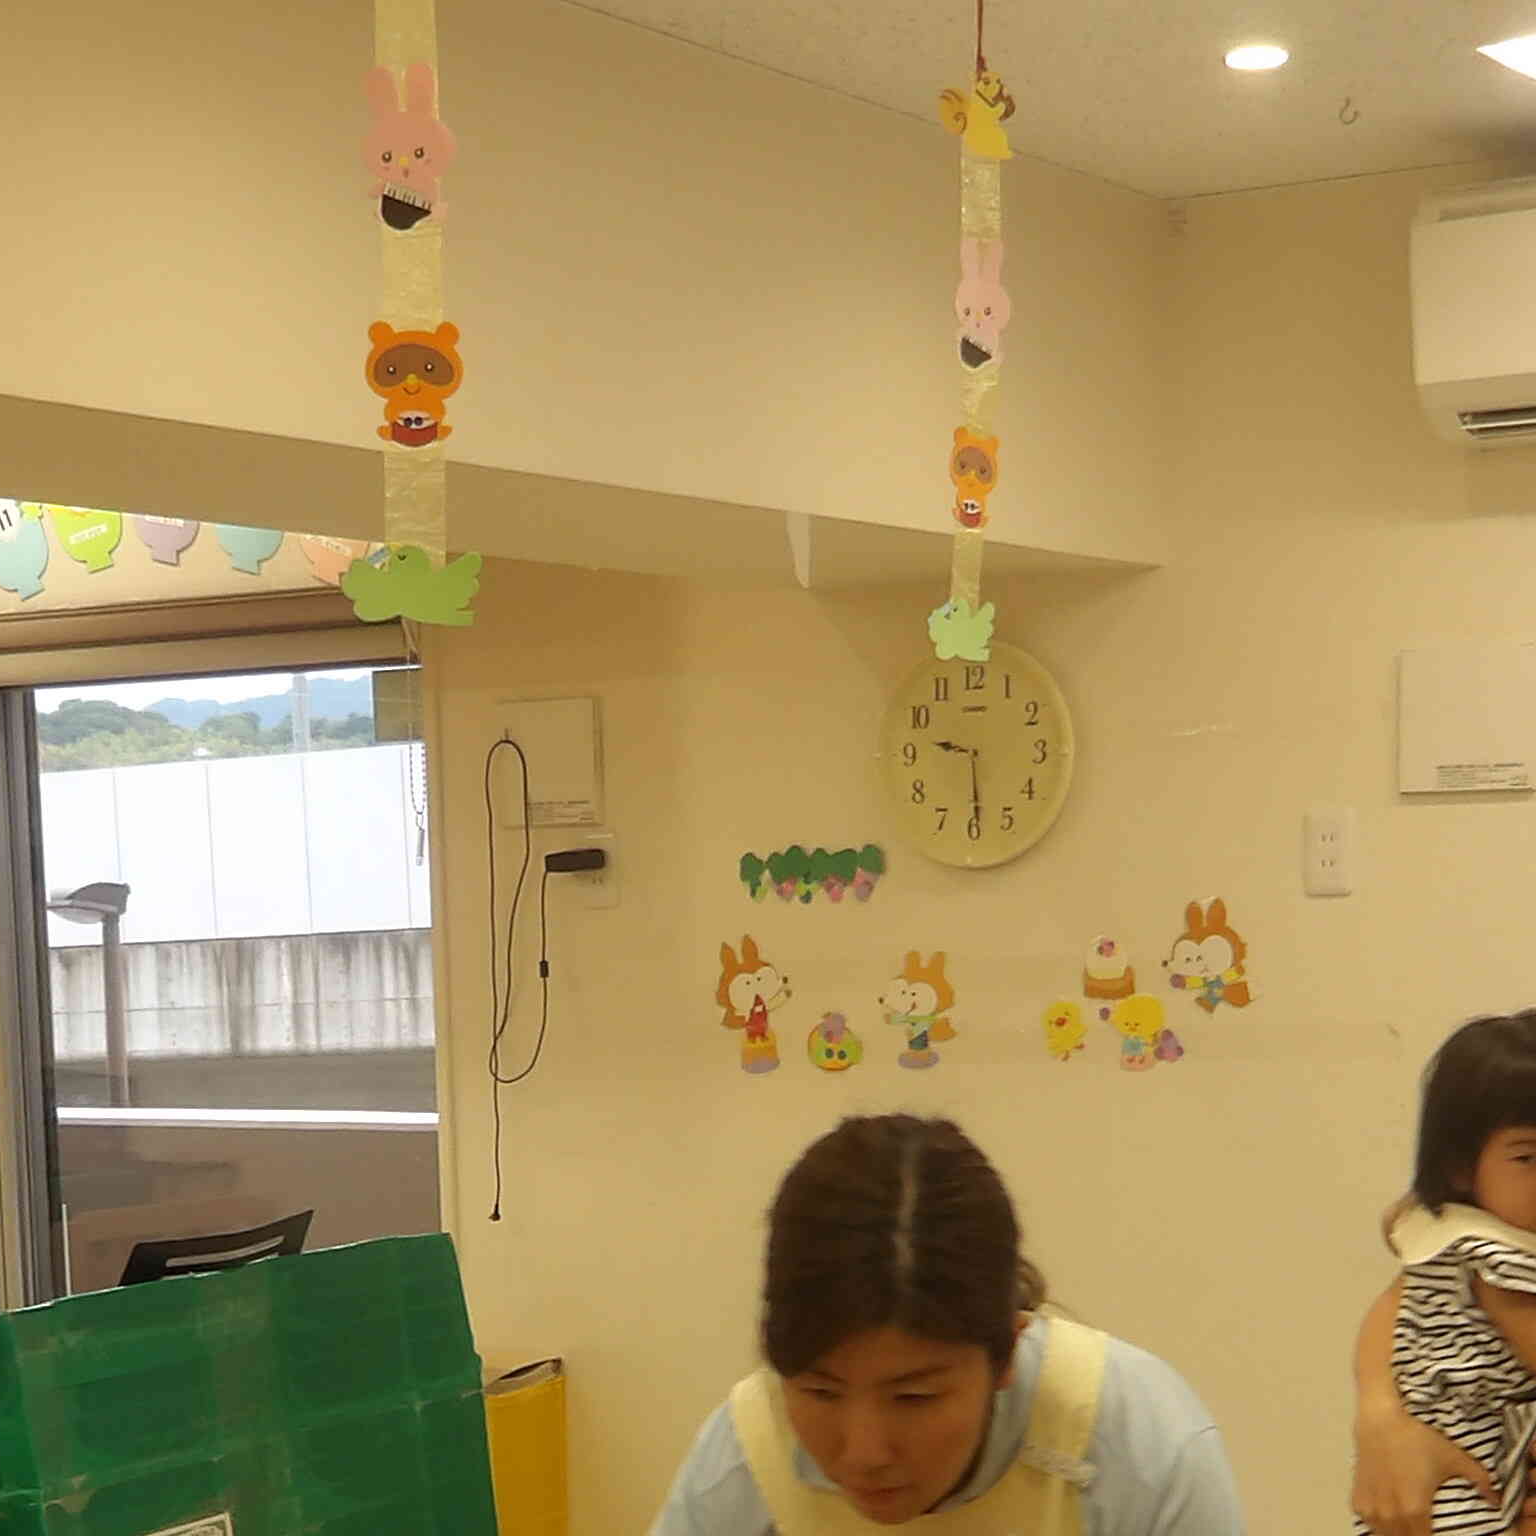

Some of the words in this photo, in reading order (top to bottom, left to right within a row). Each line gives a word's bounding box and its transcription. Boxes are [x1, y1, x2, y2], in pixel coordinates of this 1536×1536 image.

[934, 677, 949, 701] 11
[964, 665, 985, 691] 12
[1004, 674, 1012, 698] 1
[911, 705, 930, 729] 10
[1025, 702, 1039, 726] 2
[903, 743, 917, 767] 9
[1033, 739, 1047, 764] 3
[912, 779, 925, 804] 8
[1021, 777, 1035, 800] 4
[935, 807, 948, 831] 7
[967, 815, 981, 840] 6
[1000, 807, 1014, 831] 5
